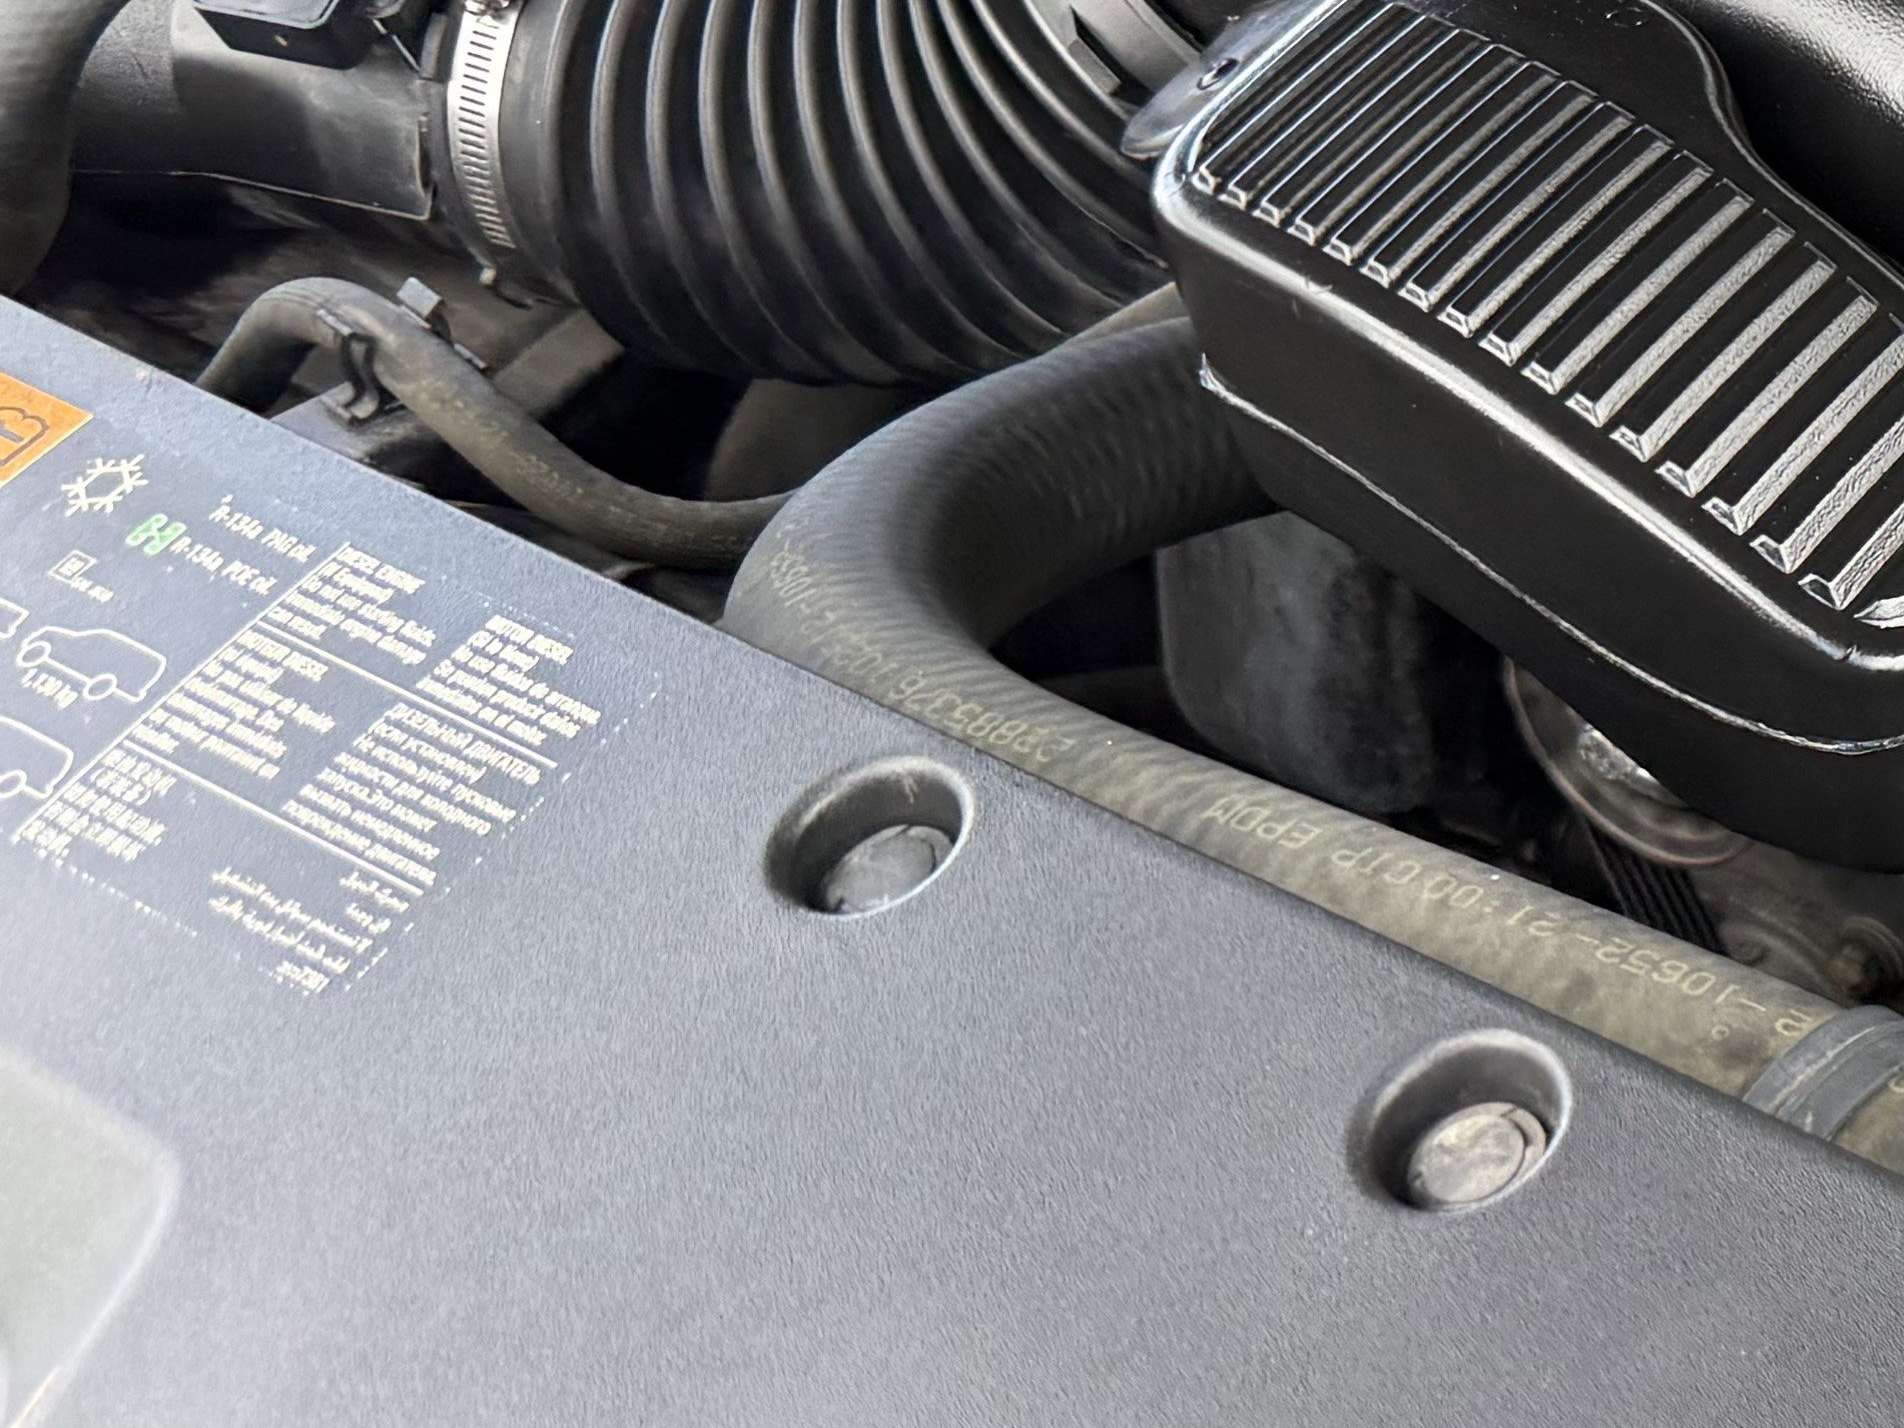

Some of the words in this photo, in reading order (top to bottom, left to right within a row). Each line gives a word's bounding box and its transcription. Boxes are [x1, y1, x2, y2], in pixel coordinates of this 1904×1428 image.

[335, 547, 381, 574] DIESEL
[485, 614, 535, 645] MOTOR
[887, 672, 1078, 764] 22885376
[1198, 794, 1324, 851] EPDM
[1329, 843, 1423, 886] CIP
